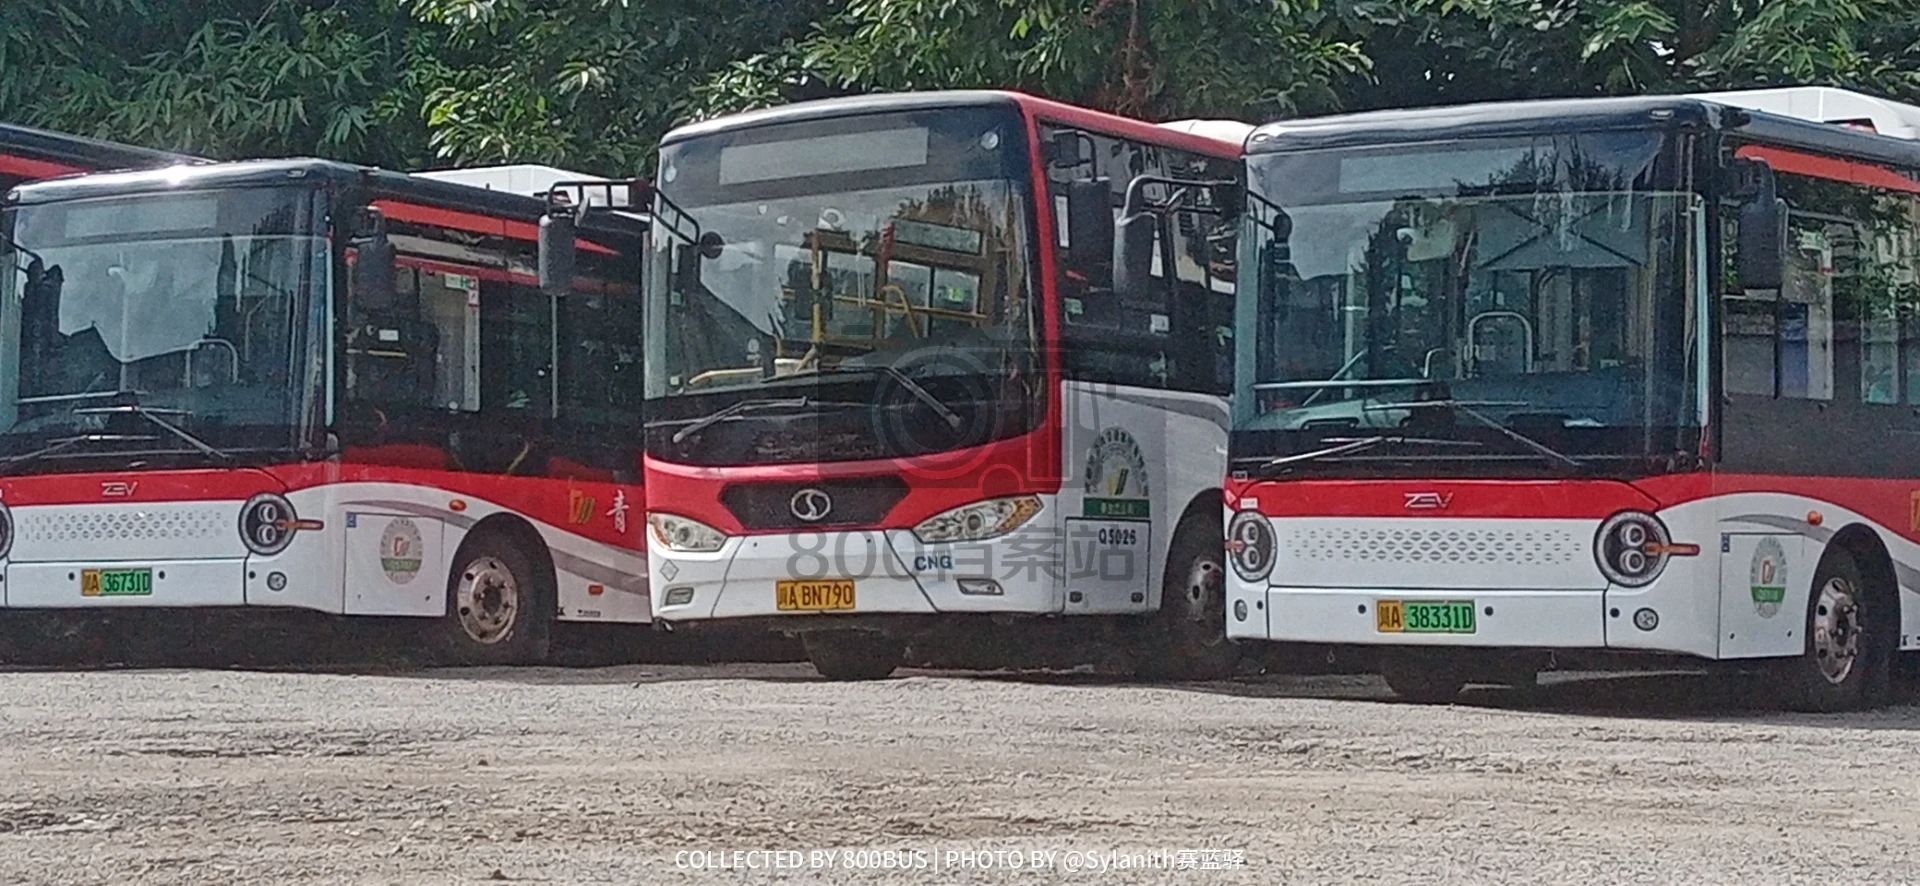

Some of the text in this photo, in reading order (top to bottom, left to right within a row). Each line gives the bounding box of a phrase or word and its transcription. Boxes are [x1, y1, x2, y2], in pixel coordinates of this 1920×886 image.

[101, 481, 138, 496] ZEV
[1404, 492, 1453, 508] ZEV
[606, 489, 630, 533] 青
[914, 556, 953, 571] CNG
